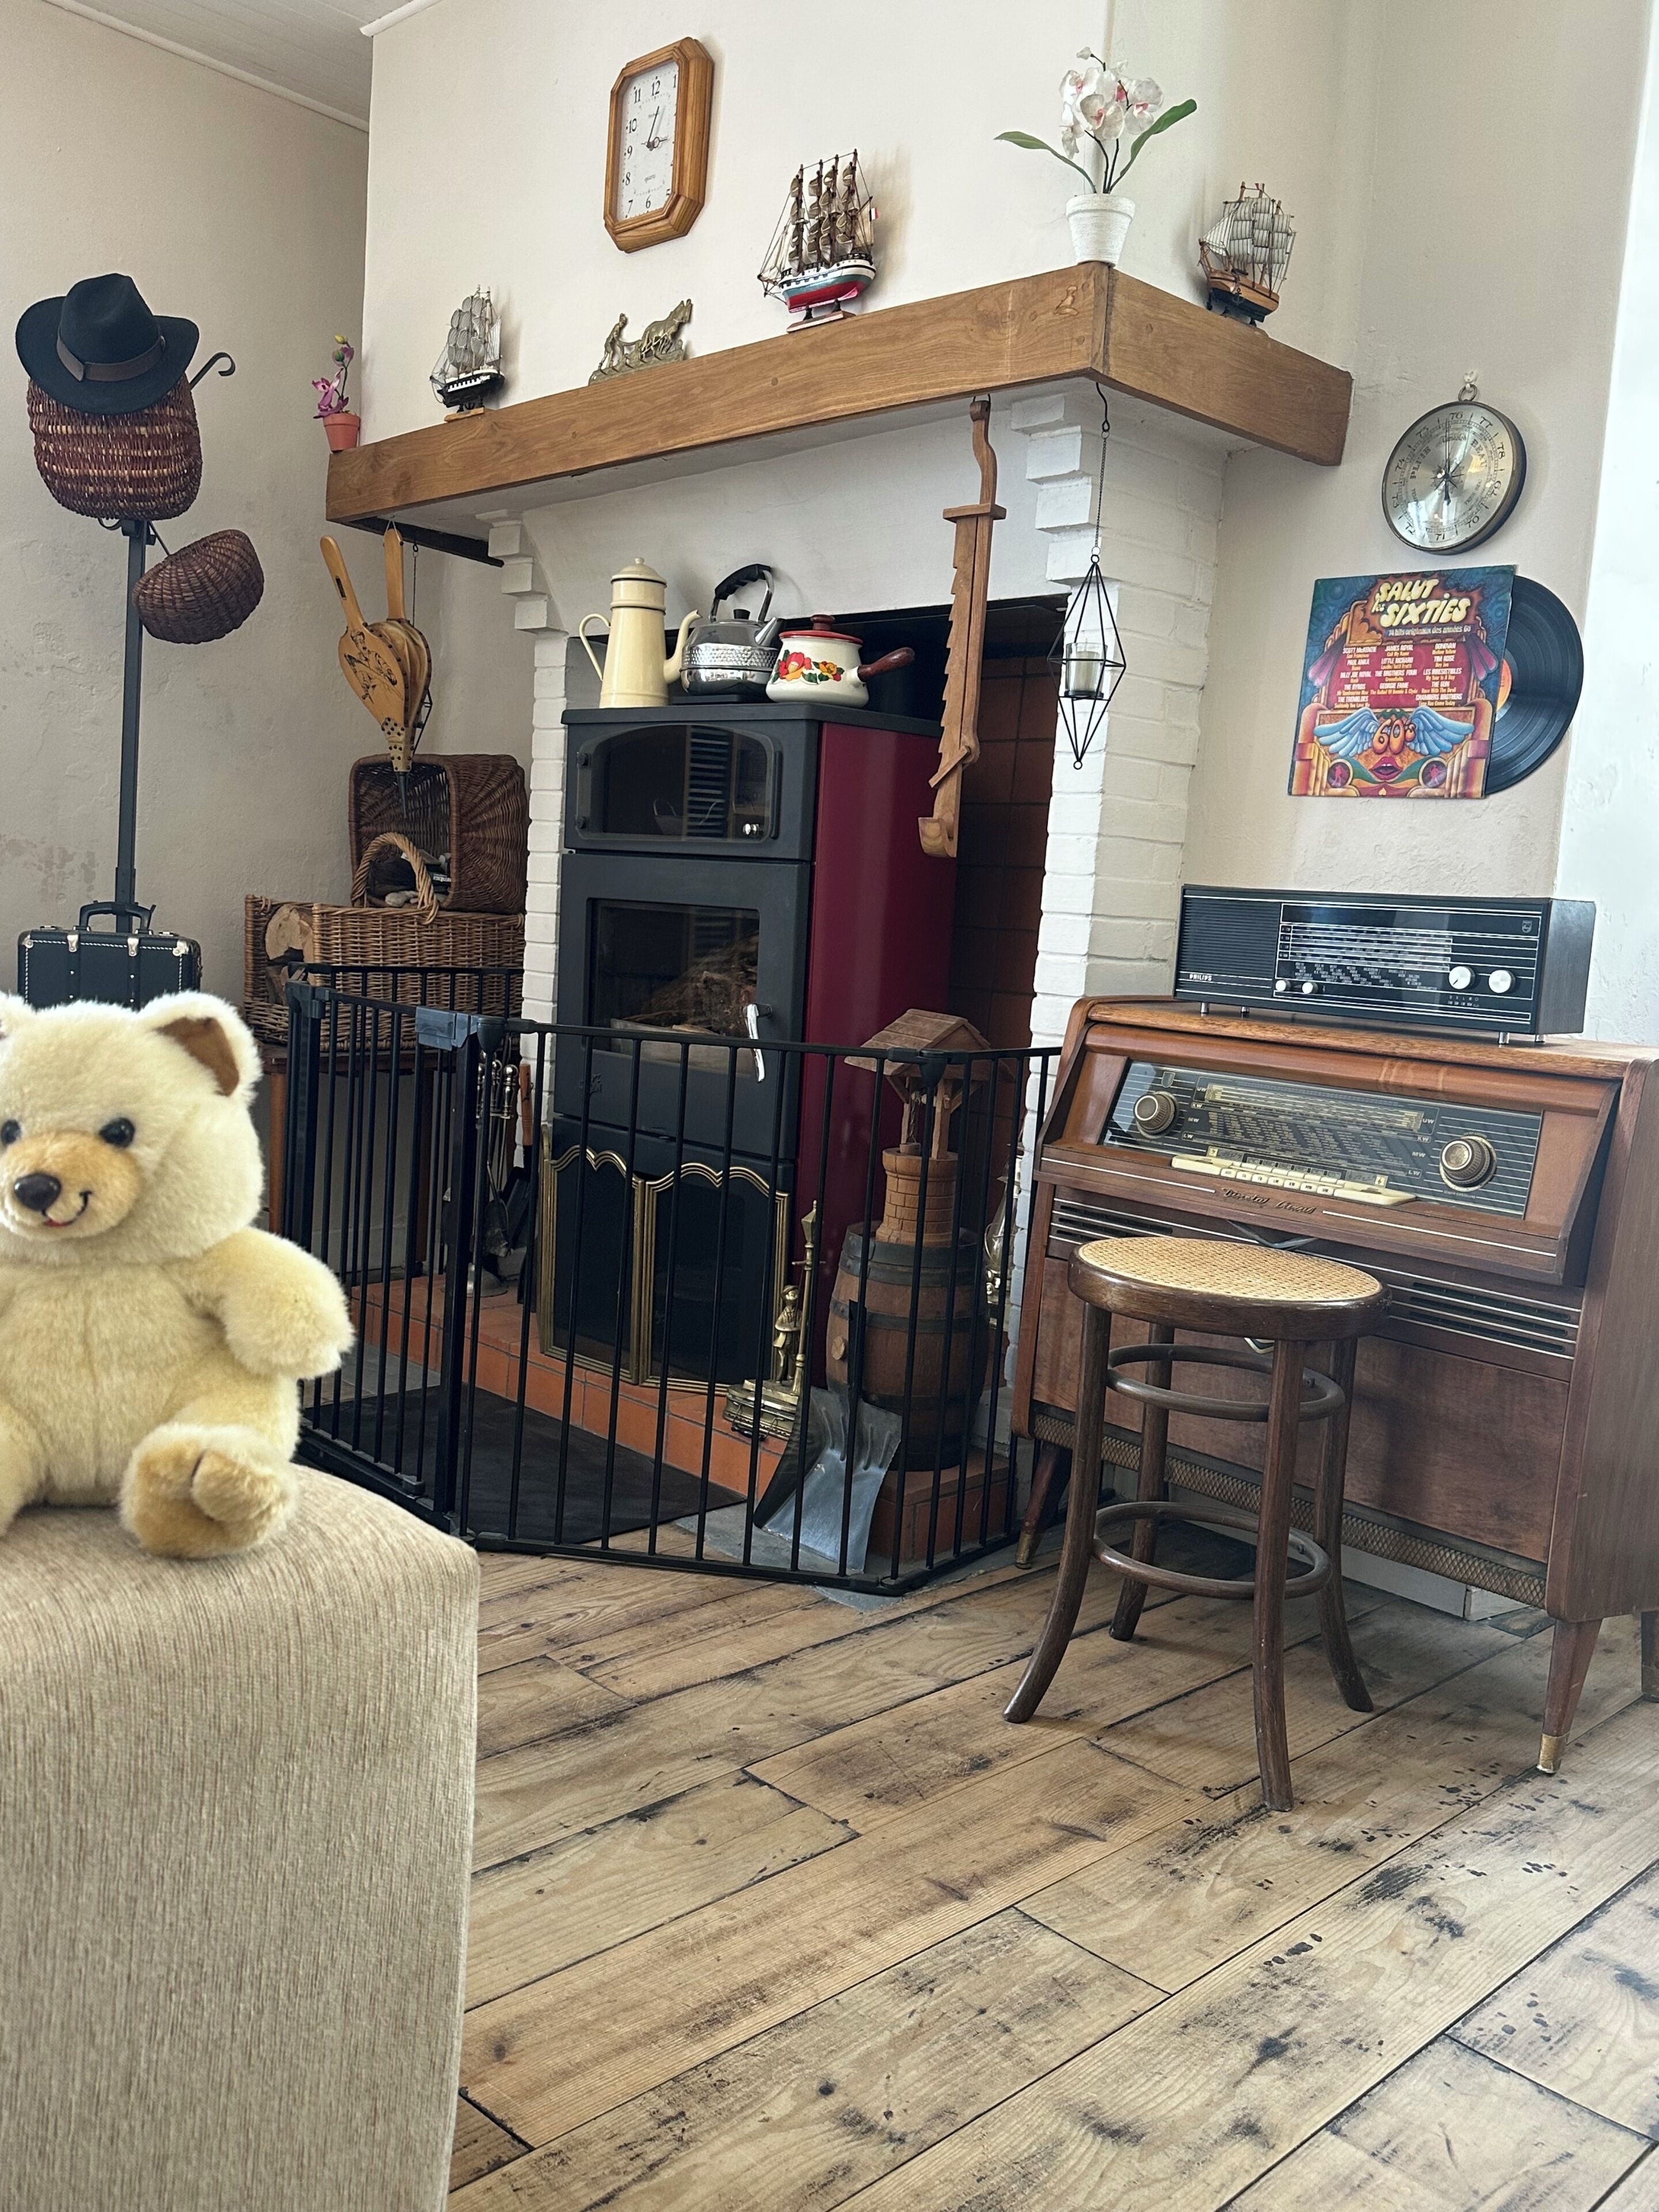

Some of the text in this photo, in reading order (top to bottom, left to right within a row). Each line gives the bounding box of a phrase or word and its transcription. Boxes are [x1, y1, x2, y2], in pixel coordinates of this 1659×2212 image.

[651, 80, 661, 97] 12
[673, 74, 677, 88] 1
[634, 88, 641, 104] 11
[628, 118, 637, 134] 10
[627, 145, 632, 160] 9
[625, 172, 631, 185] 8
[627, 199, 634, 214] 7
[646, 195, 651, 209] 6
[1449, 411, 1463, 420] 76
[1479, 416, 1493, 428] 77
[1498, 441, 1505, 460] 78
[1490, 480, 1502, 497] 79
[1392, 493, 1400, 509] 73
[1406, 521, 1416, 536] 72
[1465, 515, 1480, 528] 70
[1376, 579, 1439, 602] SALUT
[1371, 593, 1471, 627] les SIXTIES
